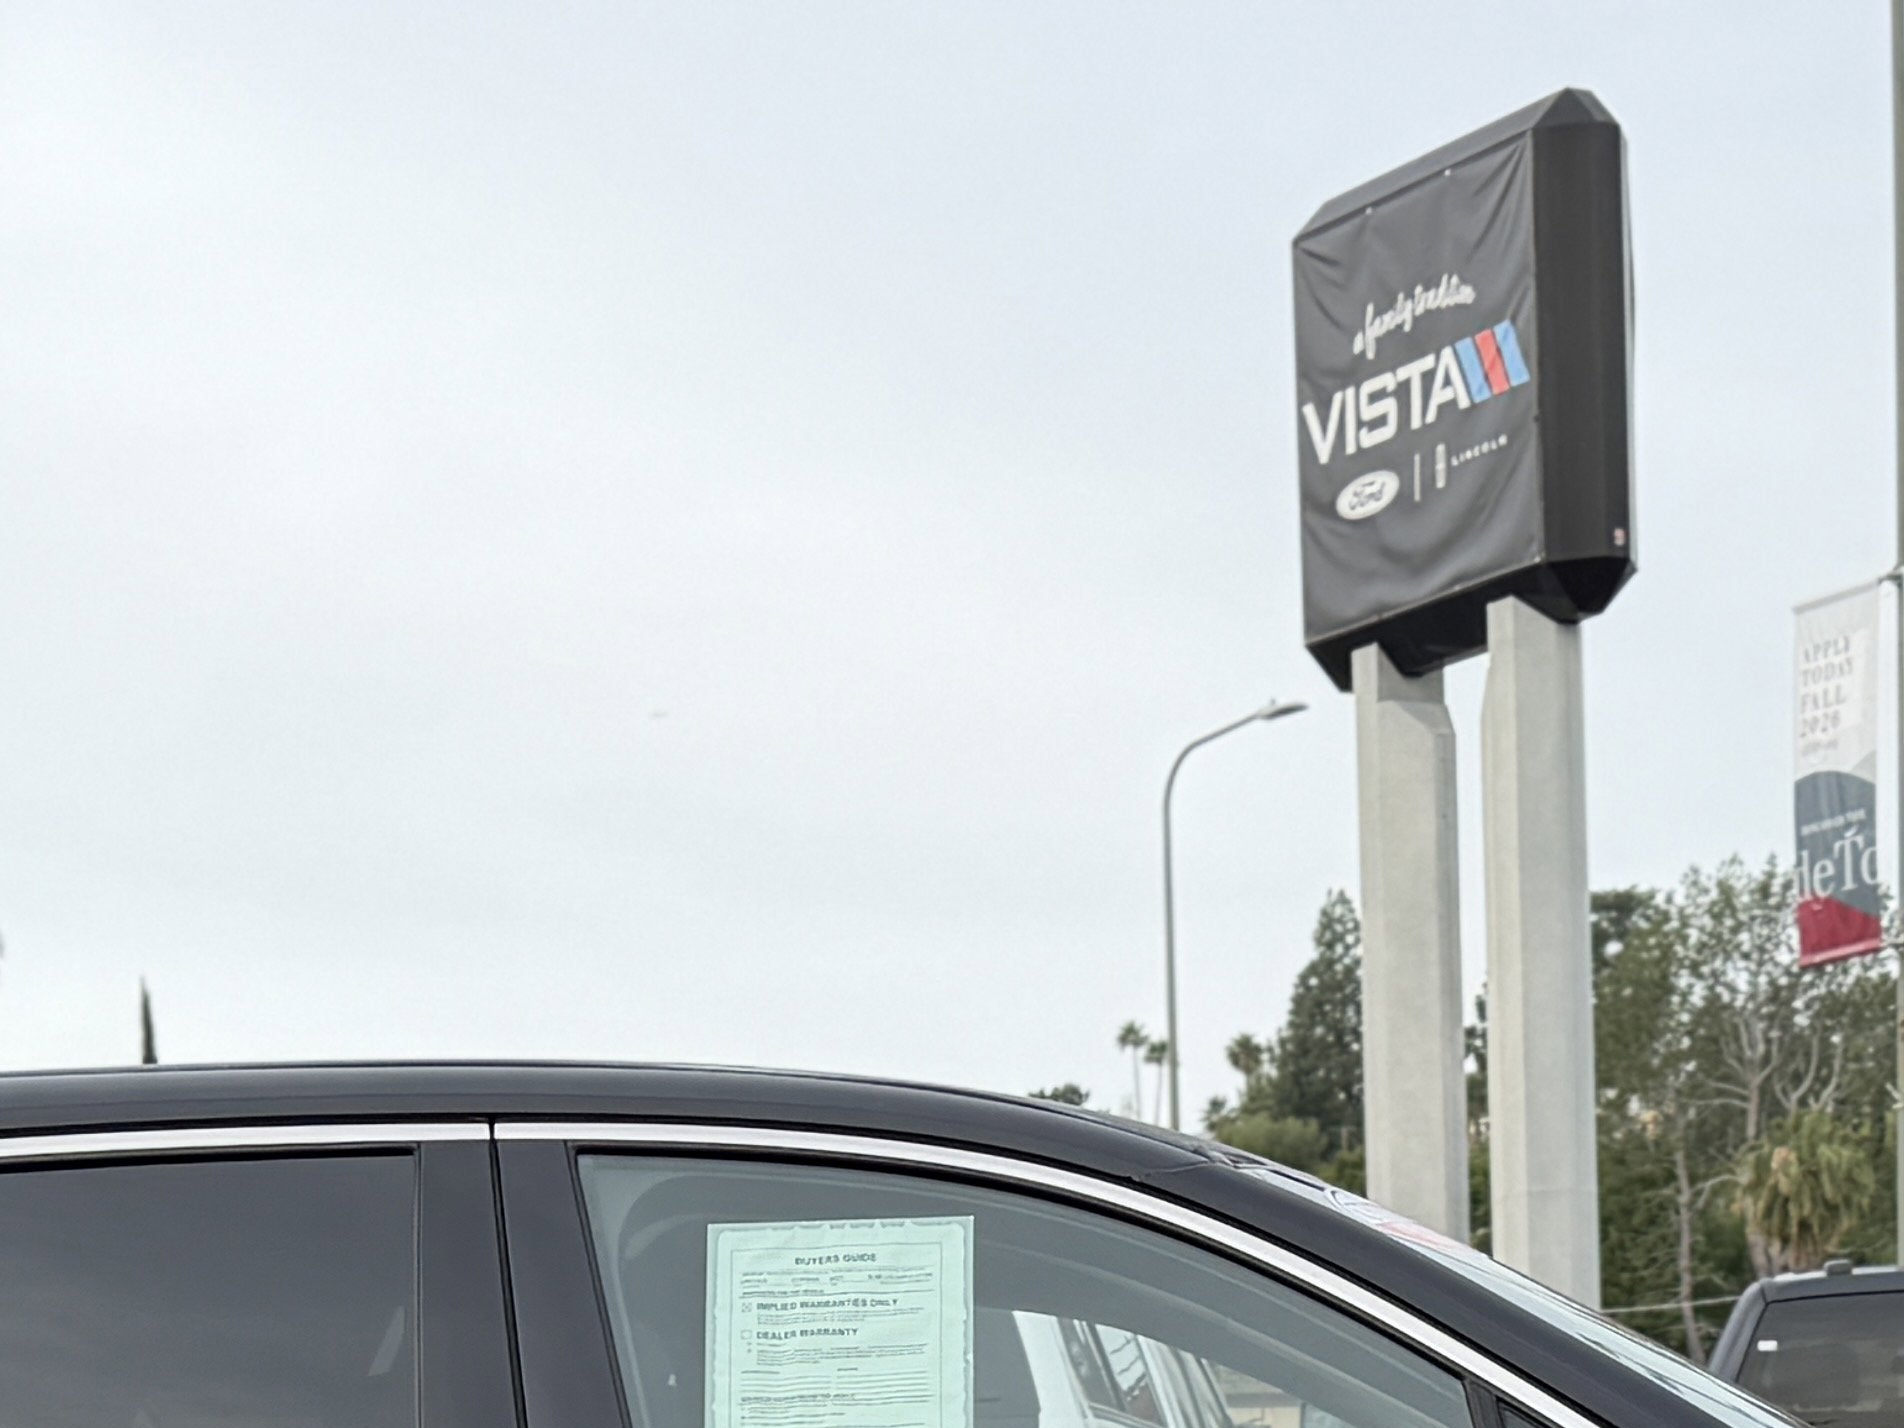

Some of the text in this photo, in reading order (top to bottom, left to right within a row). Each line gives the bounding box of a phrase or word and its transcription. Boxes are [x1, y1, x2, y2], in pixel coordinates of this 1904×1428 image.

[1302, 345, 1471, 466] VISTA
[1801, 657, 1854, 688] TODAY
[1799, 685, 1846, 714] FALL
[795, 1252, 877, 1266] BUYERS GUIDE
[756, 1301, 797, 1312] IMPLIED
[756, 1327, 859, 1341] DEALER WARRANTY
